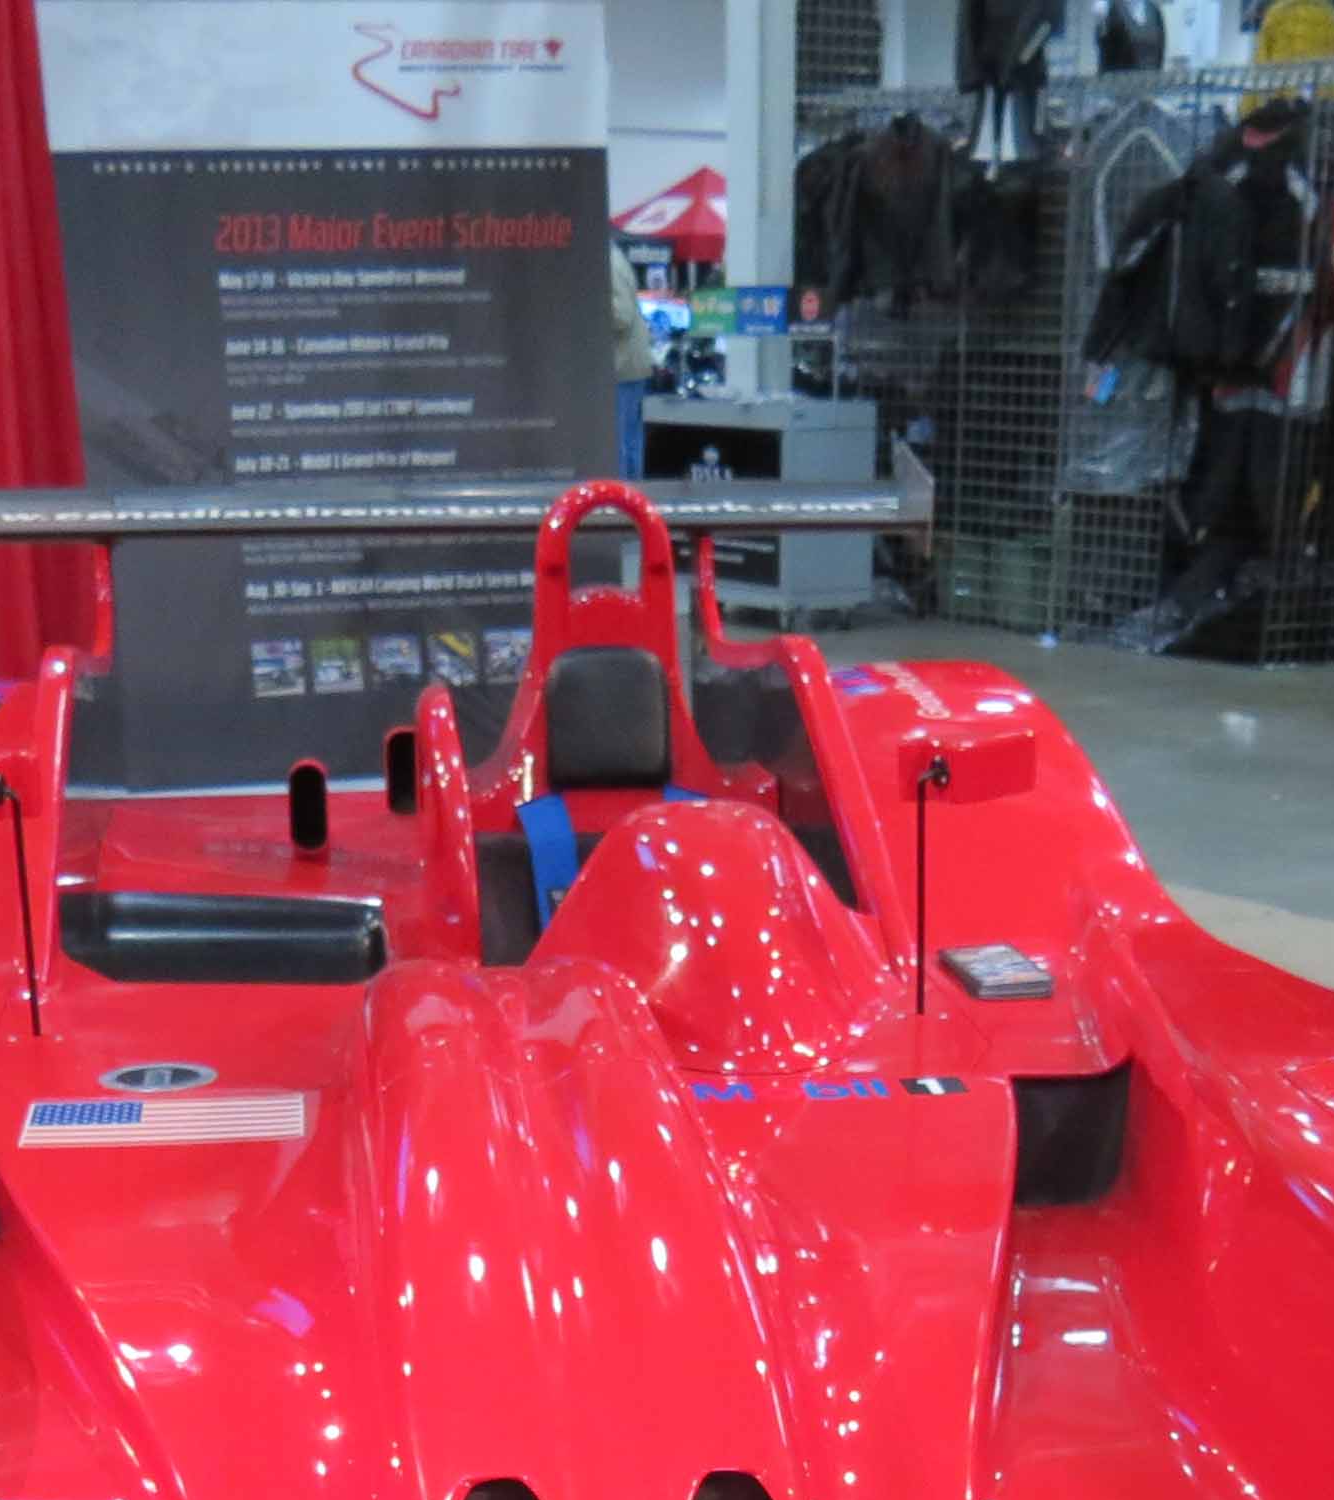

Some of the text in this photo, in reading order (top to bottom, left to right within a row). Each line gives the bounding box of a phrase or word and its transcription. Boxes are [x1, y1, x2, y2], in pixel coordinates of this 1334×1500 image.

[215, 211, 572, 253] 2013 Major Event Schedule
[690, 1078, 890, 1101] Mbil
